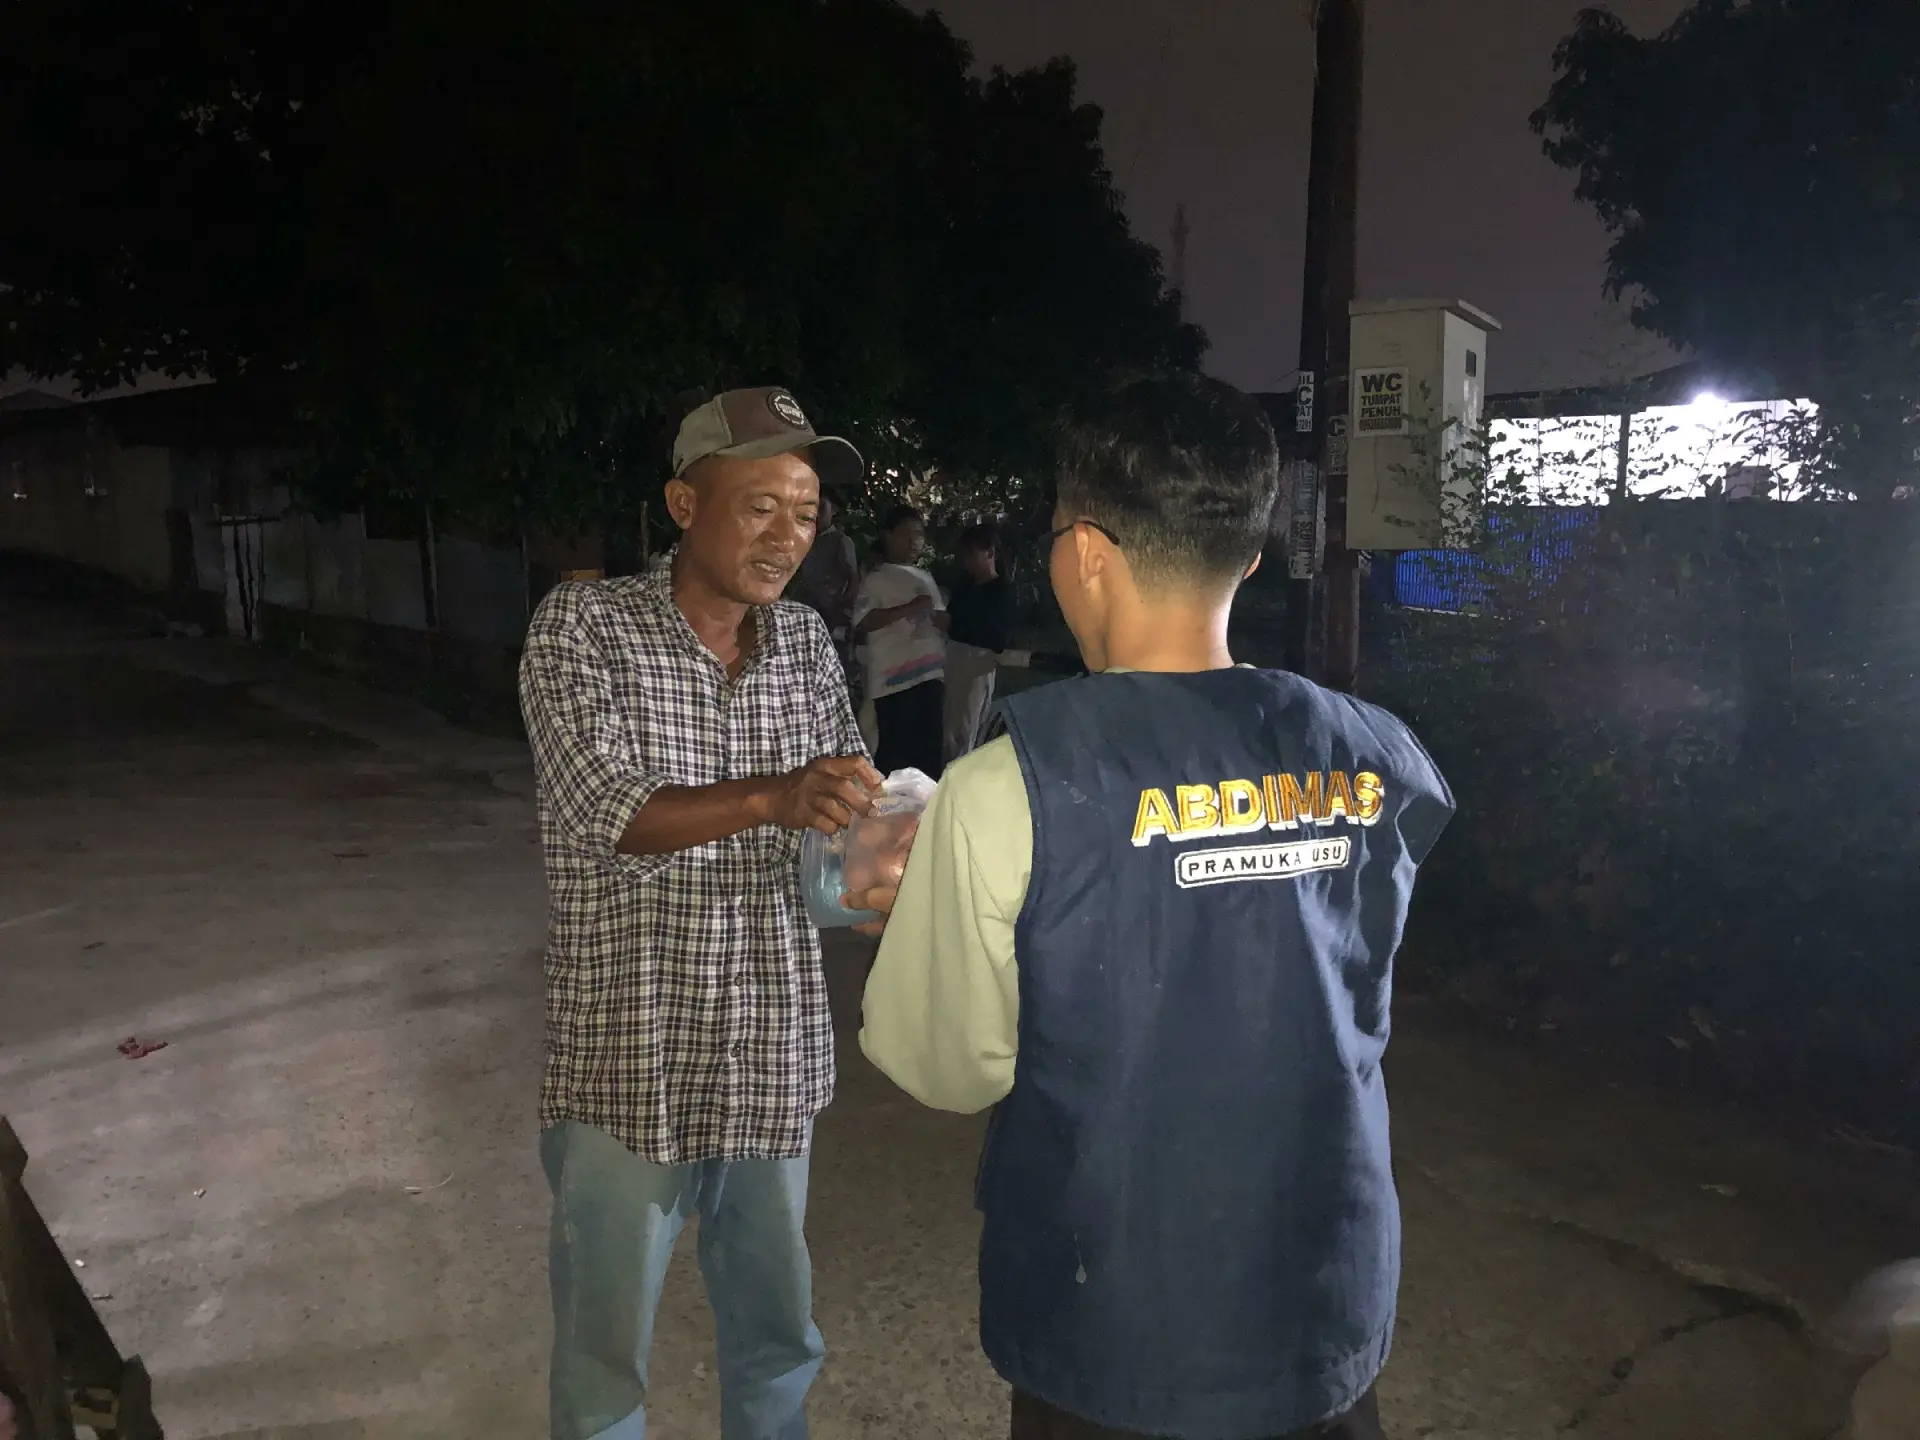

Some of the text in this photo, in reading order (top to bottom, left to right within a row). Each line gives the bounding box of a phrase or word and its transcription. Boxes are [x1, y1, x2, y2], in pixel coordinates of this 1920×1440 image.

[1361, 373, 1402, 393] WC
[1361, 394, 1402, 405] TUMPAT
[1361, 405, 1401, 417] PENUH
[1130, 770, 1385, 847] ABDIMAS
[1188, 845, 1342, 877] PRAMUKA USU
